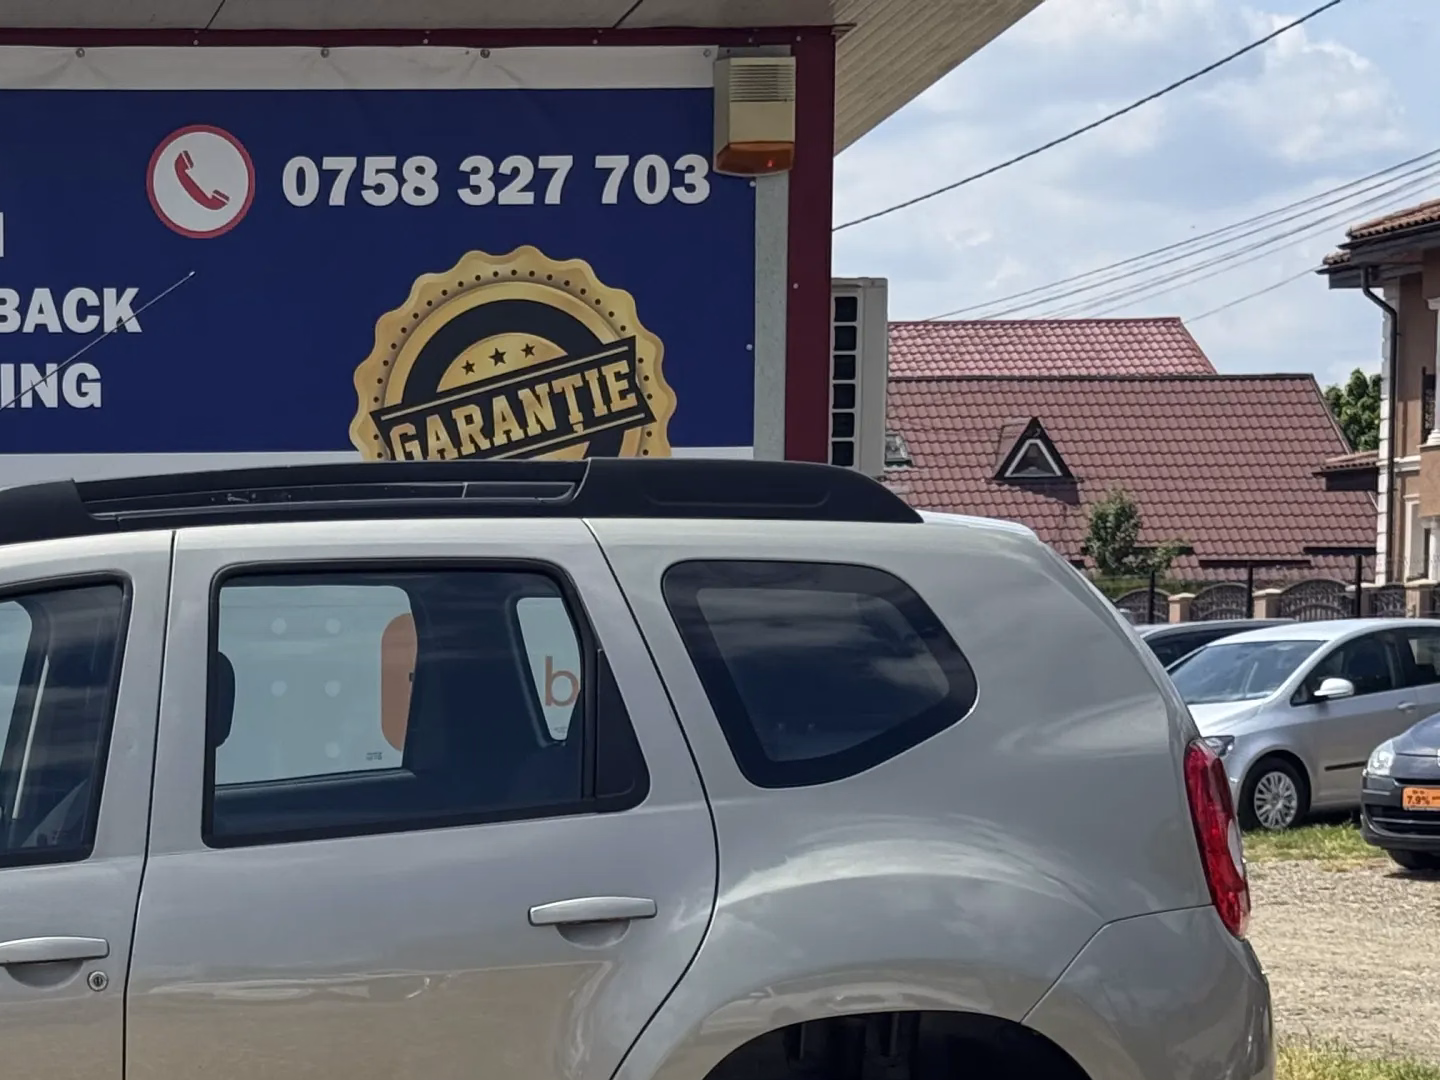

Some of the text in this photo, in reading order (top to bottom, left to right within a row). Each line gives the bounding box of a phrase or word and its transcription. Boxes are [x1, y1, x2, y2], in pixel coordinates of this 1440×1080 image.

[282, 153, 711, 207] 0758 327 703
